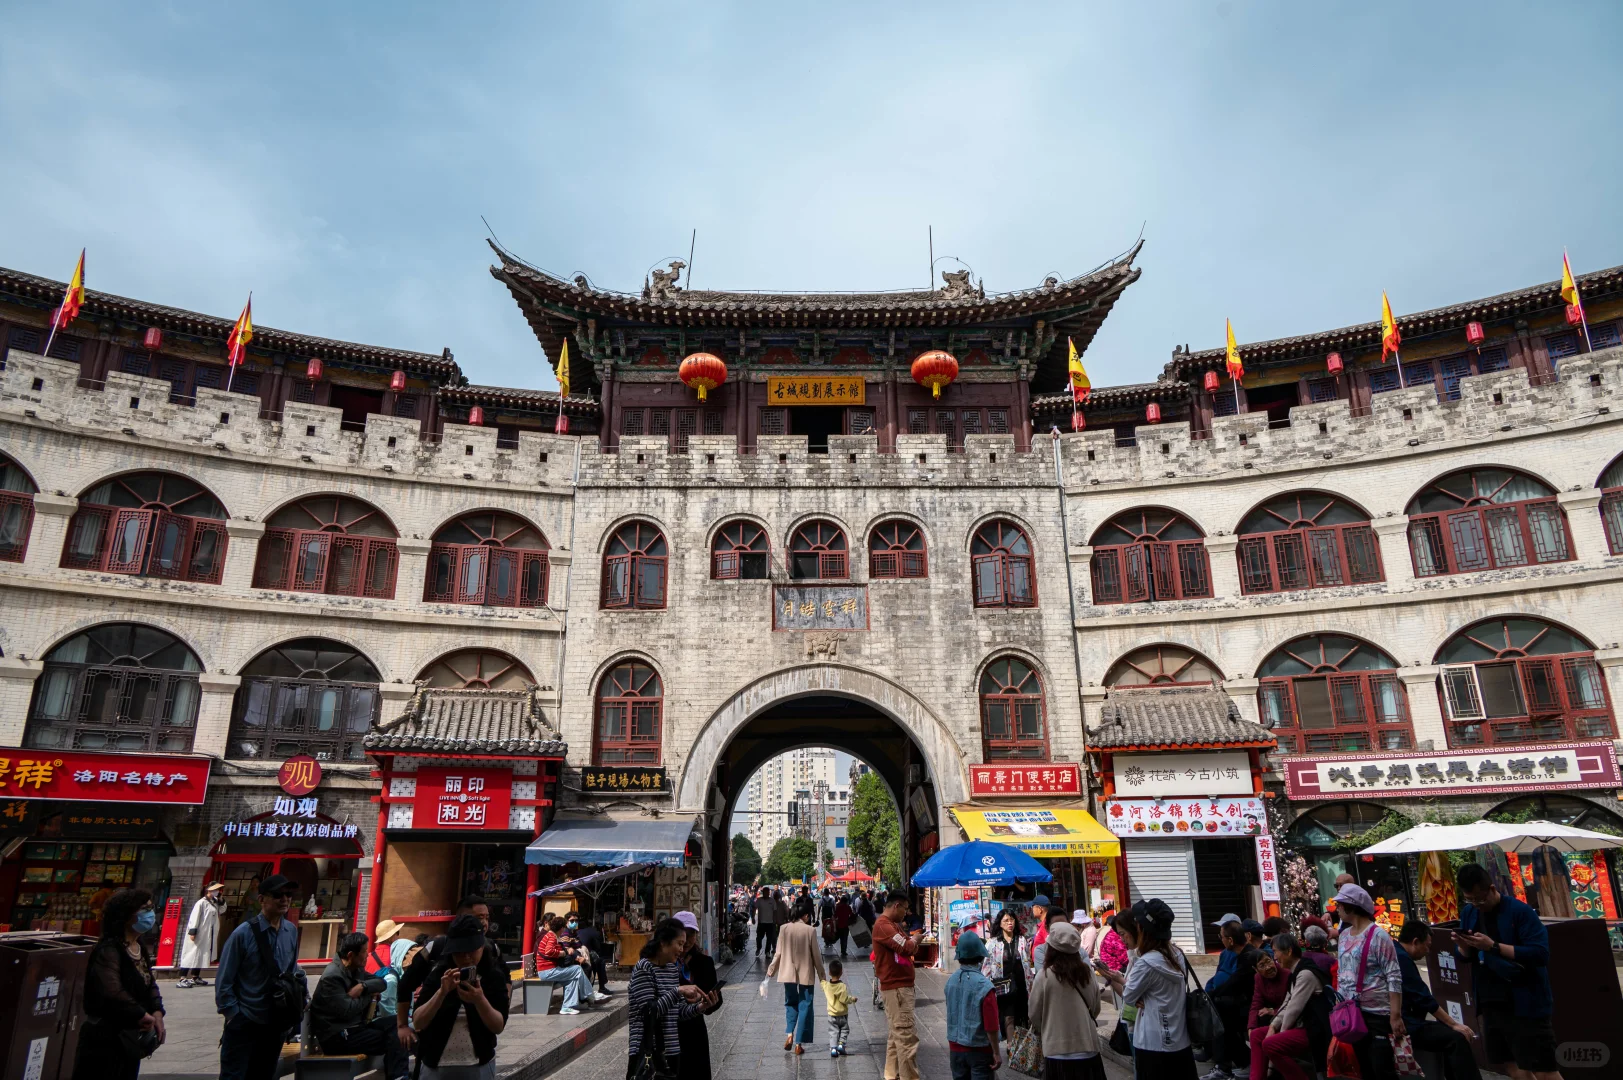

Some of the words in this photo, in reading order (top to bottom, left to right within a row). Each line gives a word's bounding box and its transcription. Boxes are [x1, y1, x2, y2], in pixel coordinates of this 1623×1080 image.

[0, 758, 52, 789] 祥
[73, 770, 188, 786] 洛阳名特产
[977, 770, 1072, 785] 丽景门便利店
[445, 776, 484, 793] 丽印
[272, 796, 318, 818] 如观
[441, 804, 482, 821] 和光
[69, 817, 154, 825] 非物质文化遗产
[224, 822, 357, 838] 中国非遗文化原创品牌
[1258, 838, 1275, 882] 寄存包裹
